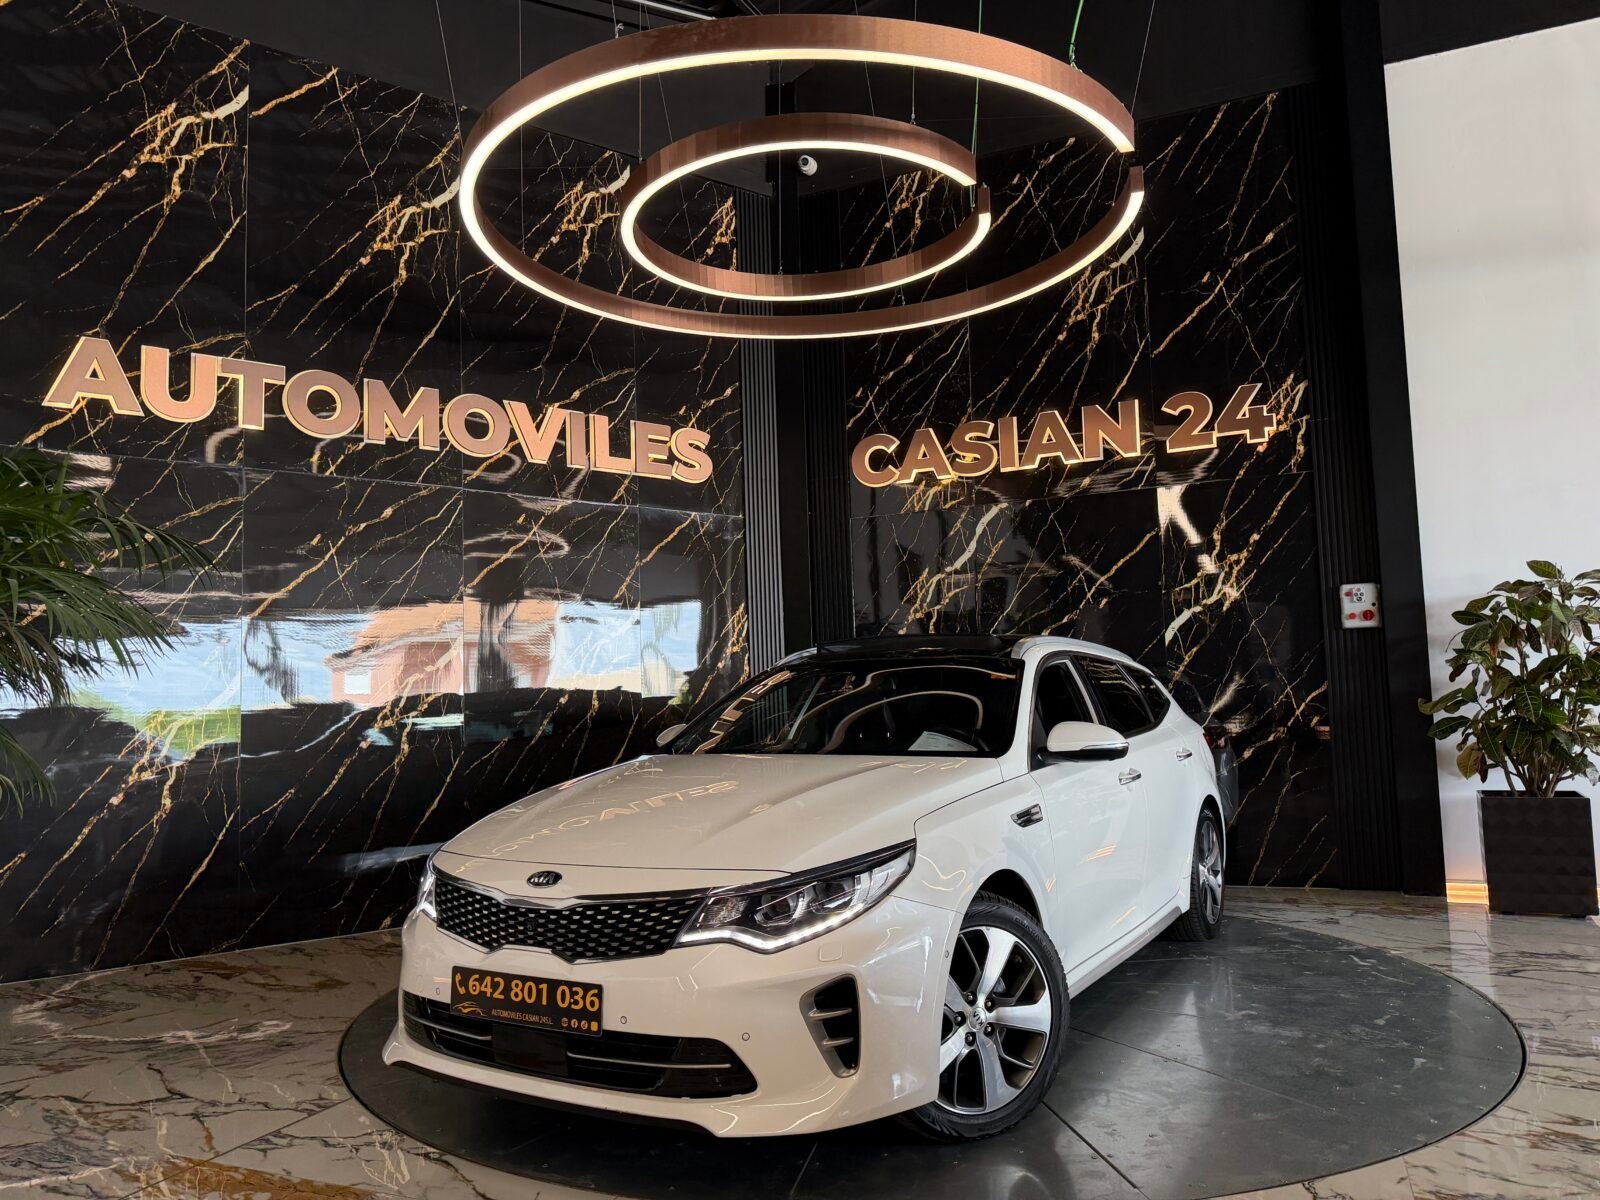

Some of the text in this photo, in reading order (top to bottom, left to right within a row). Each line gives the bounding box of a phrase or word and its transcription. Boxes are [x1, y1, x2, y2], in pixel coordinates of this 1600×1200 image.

[42, 336, 713, 483] AUTOMOVILES
[851, 383, 1277, 488] CASIAN 24
[530, 872, 556, 884] KIA
[468, 974, 599, 1012] 642 801 036
[491, 1008, 523, 1020] AUTOMOVILES
[523, 1013, 539, 1023] CASIAN
[973, 1010, 985, 1027] KIA
